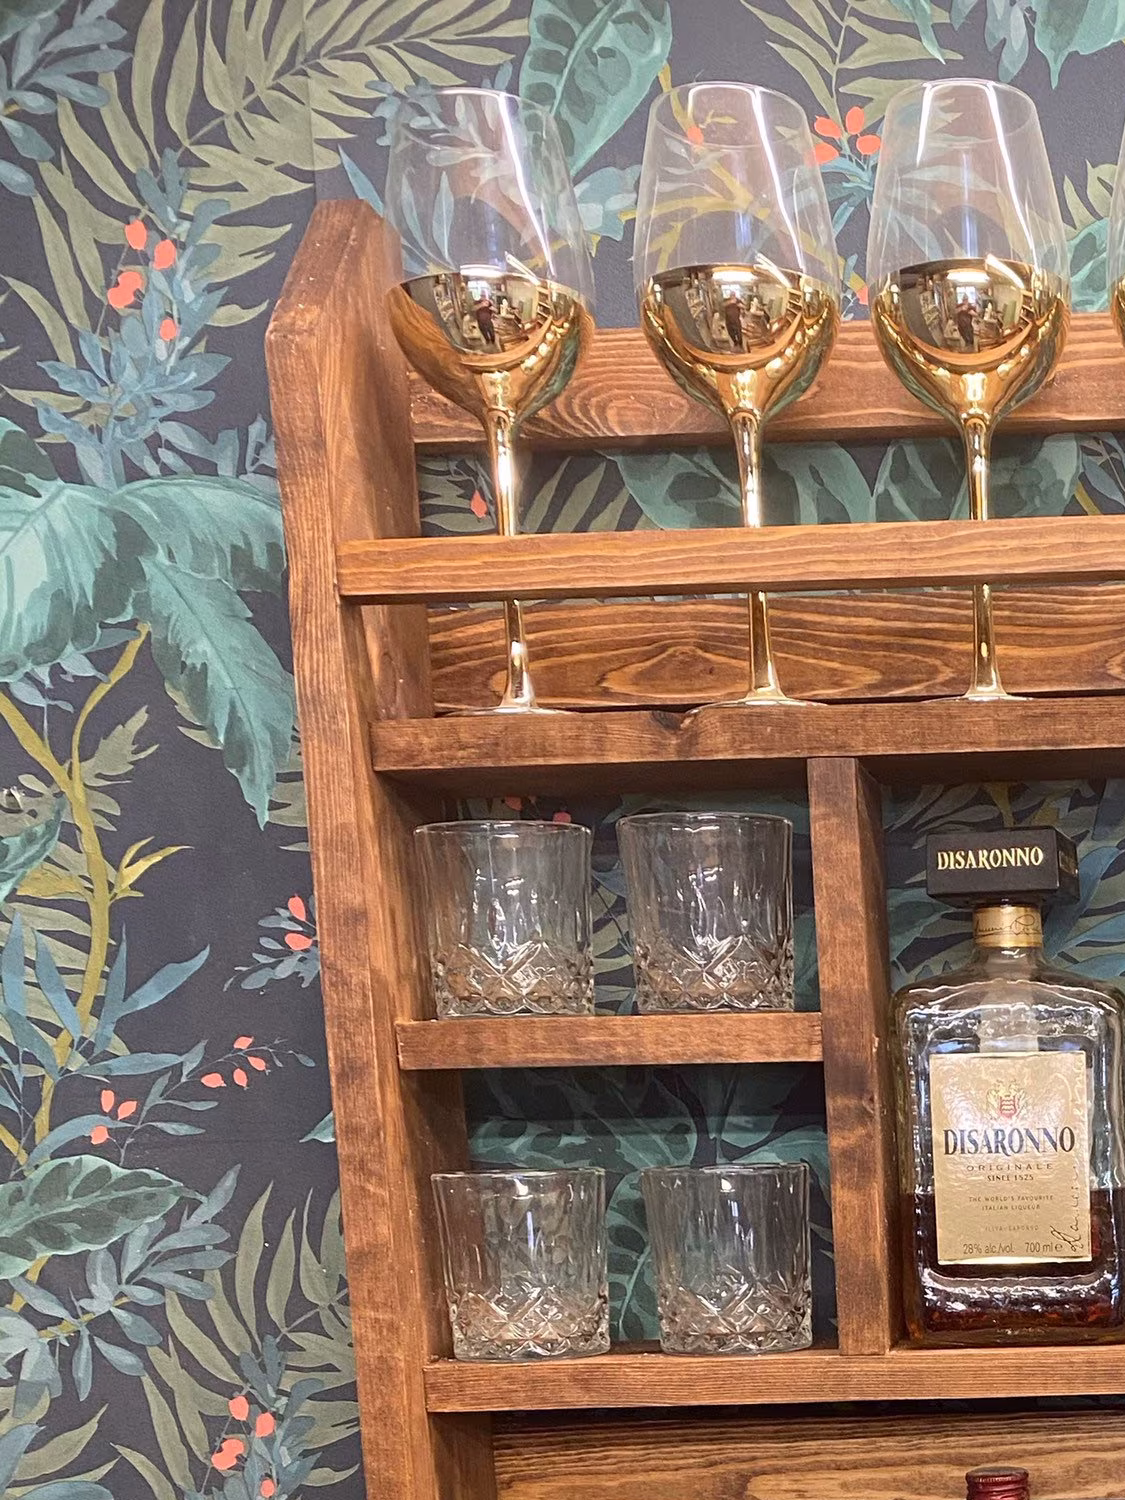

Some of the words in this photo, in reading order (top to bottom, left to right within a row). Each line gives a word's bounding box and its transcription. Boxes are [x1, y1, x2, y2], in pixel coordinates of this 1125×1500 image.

[937, 846, 1044, 870] DISARONNO
[943, 1126, 1075, 1156] DISARONNO
[966, 1163, 1053, 1171] ORIGINALE
[987, 1174, 1010, 1182] SINCE
[963, 1243, 982, 1254] 28%
[1025, 1242, 1041, 1253] 700
[1042, 1242, 1054, 1253] ml
